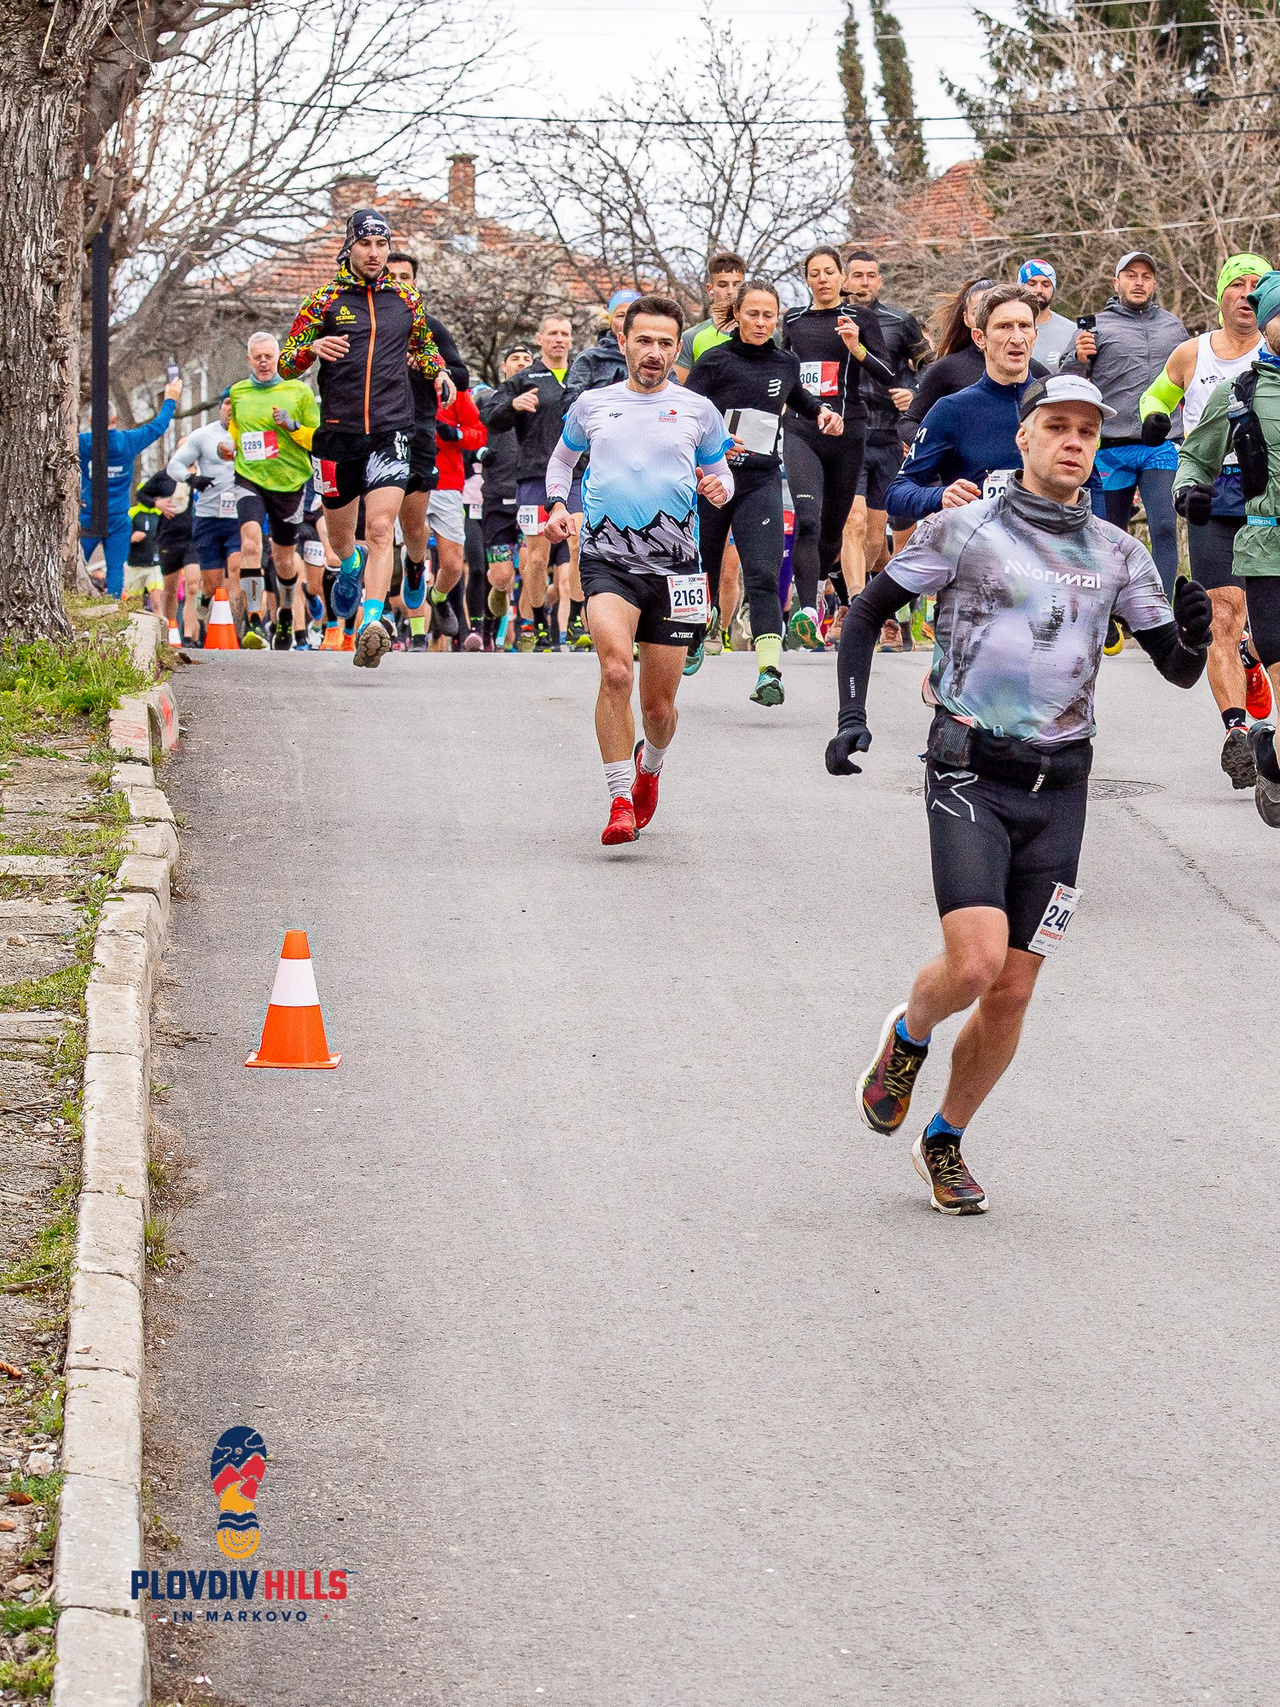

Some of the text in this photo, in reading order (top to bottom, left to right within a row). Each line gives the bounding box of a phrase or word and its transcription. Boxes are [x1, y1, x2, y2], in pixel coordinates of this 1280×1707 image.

[243, 440, 262, 450] 2289
[674, 588, 704, 607] 2163
[1042, 904, 1075, 933] 24
